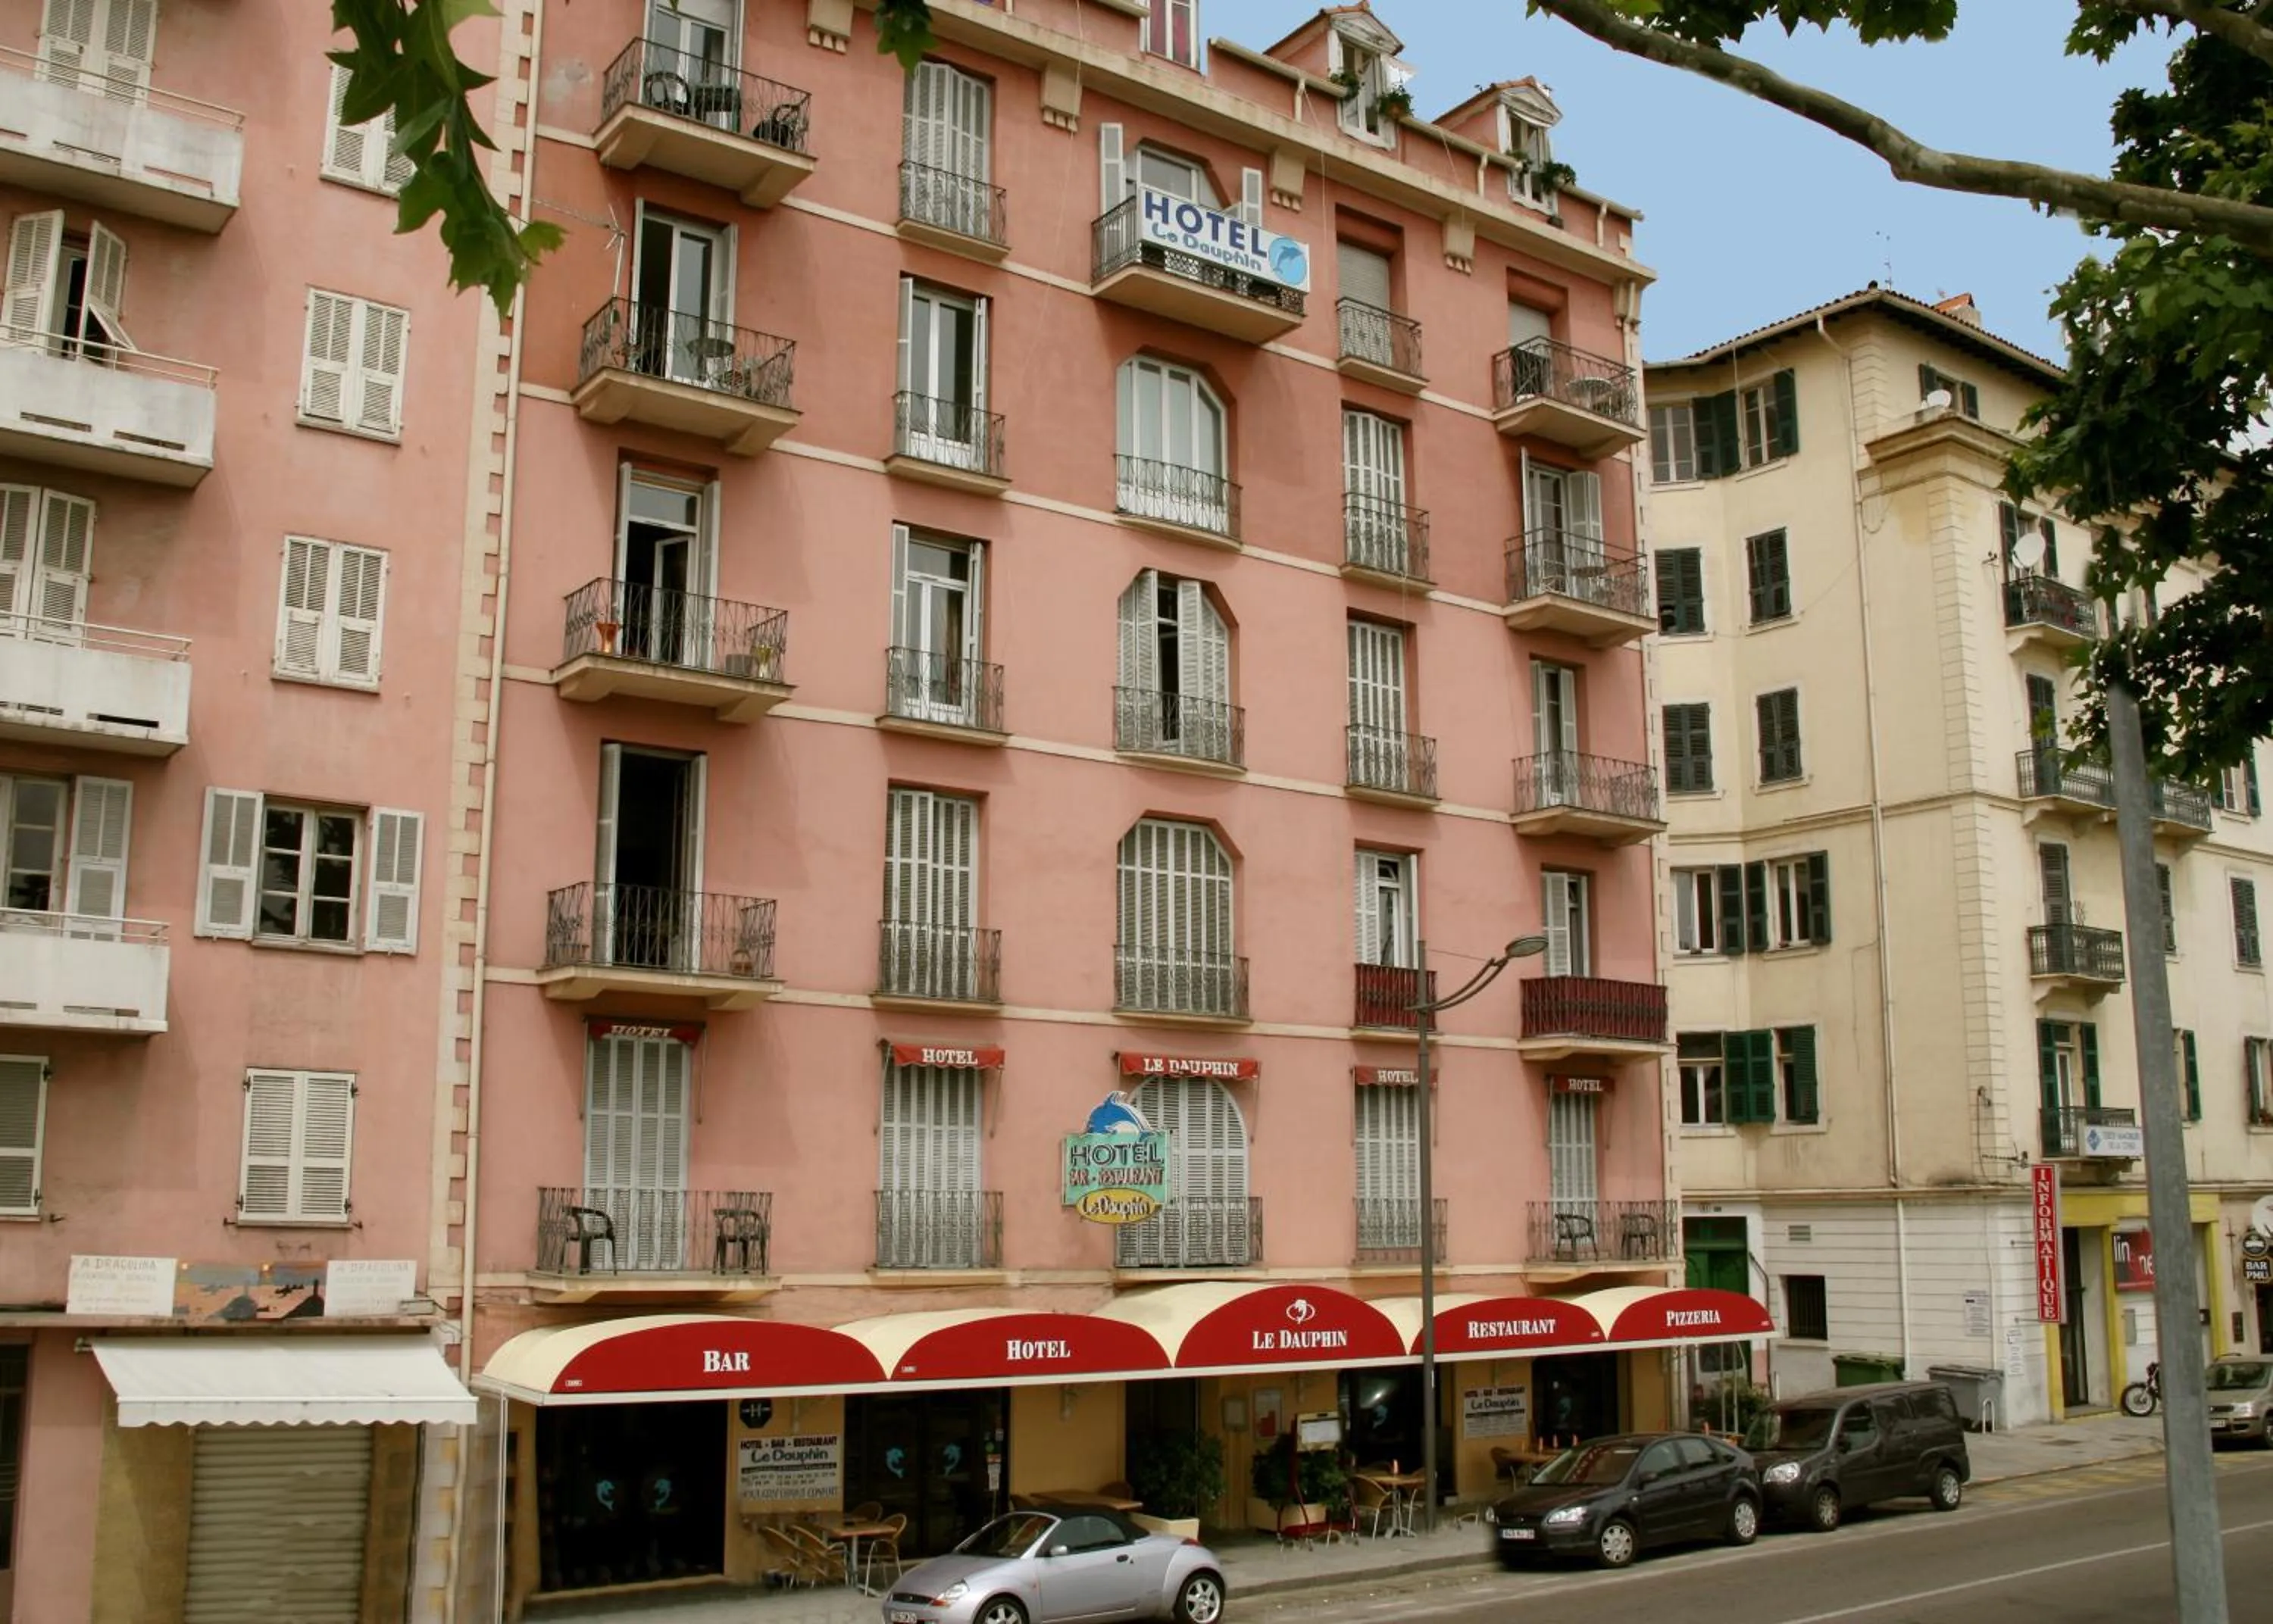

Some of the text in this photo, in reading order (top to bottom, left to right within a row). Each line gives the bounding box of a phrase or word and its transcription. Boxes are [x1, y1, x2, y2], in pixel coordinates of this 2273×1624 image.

[1145, 190, 1268, 258] HOTEL
[1151, 221, 1262, 271] Le Dauphin
[921, 1048, 978, 1065] HOTEL
[1143, 1058, 1239, 1076] LE DAUPHIN
[1377, 1069, 1419, 1083] HOTEL
[1568, 1078, 1603, 1092] HOTEL
[1070, 1142, 1165, 1166] HOTEL
[1098, 1195, 1152, 1221] Dauphin
[2036, 1169, 2056, 1320] INFORMATIQUE
[2245, 1261, 2268, 1270] BAR
[2246, 1271, 2269, 1279] PMU
[1666, 1310, 1721, 1326] PIZZERIA
[1468, 1320, 1555, 1338] RESTAURANT
[1252, 1329, 1347, 1349] LE DAUPHIN
[1006, 1340, 1071, 1360] HOTEL
[703, 1351, 751, 1373] BAR
[740, 1440, 761, 1450] HOTEL
[793, 1436, 837, 1447] RESTAURANT
[751, 1447, 829, 1464] Le Dauphin
